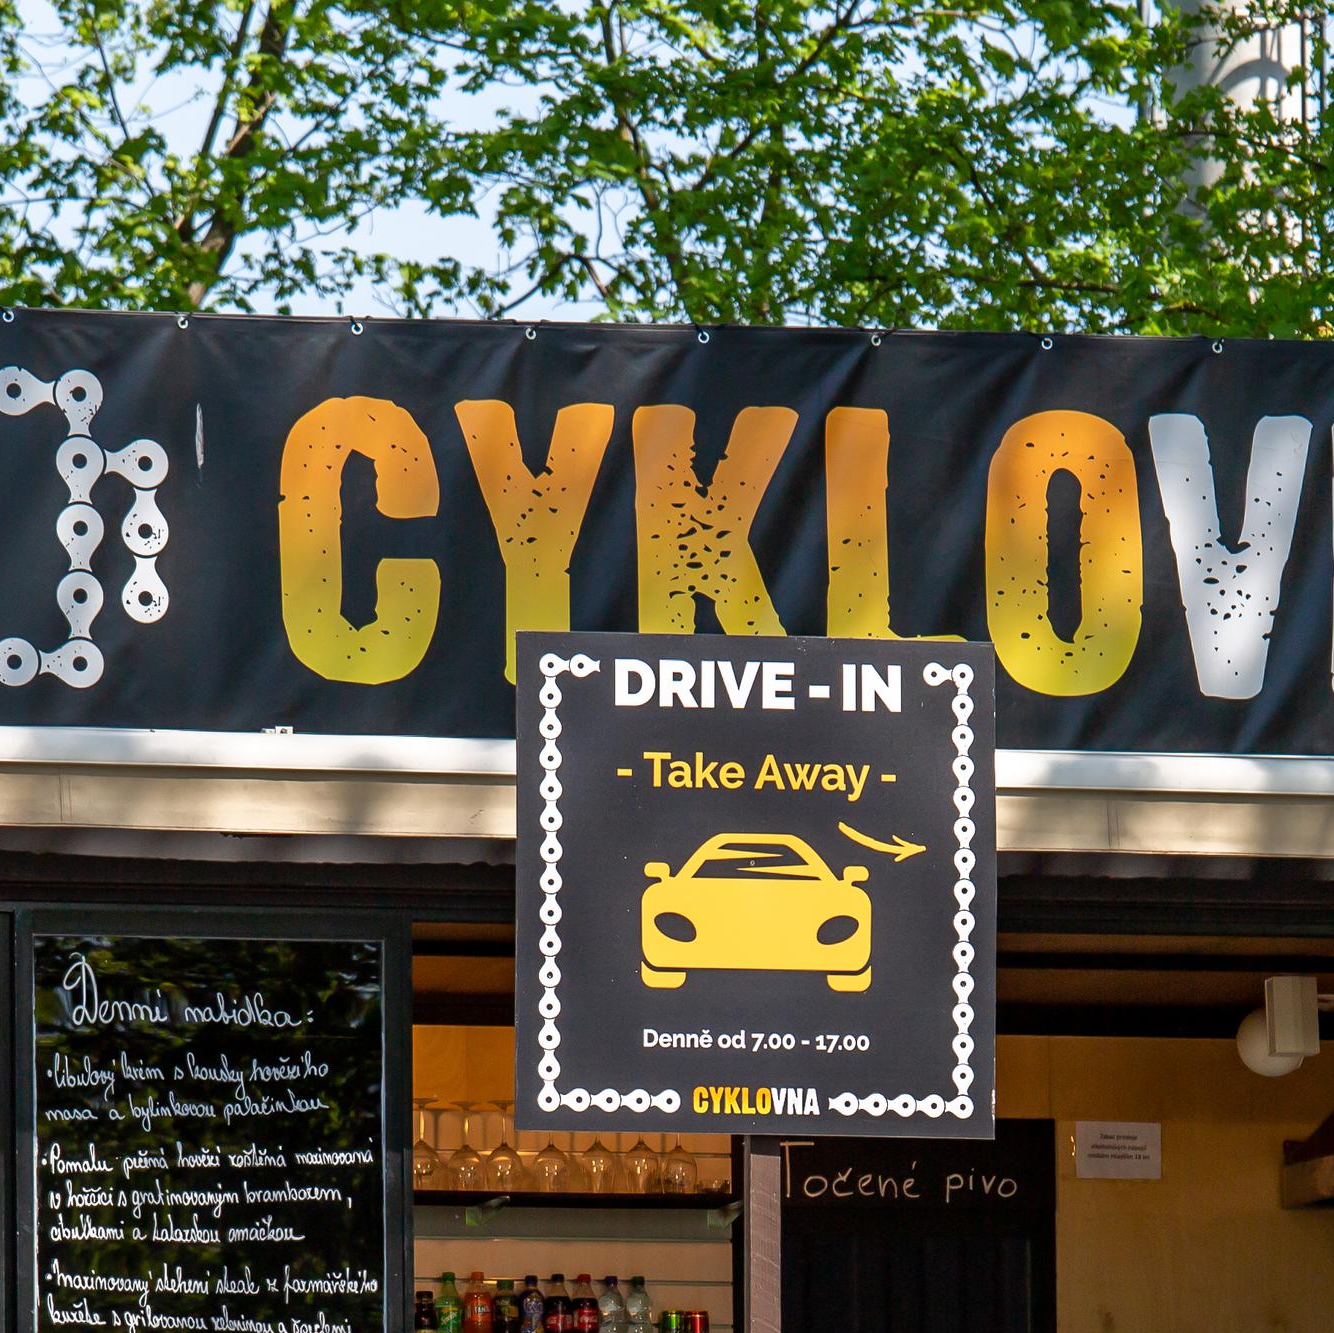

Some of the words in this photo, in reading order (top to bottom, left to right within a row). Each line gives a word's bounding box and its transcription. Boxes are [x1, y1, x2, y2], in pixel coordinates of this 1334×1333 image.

[614, 658, 796, 711] DRIVE
[842, 664, 902, 713] IN
[642, 751, 746, 790] Take
[754, 754, 870, 801] Away
[642, 1028, 713, 1049] Denně
[717, 1029, 747, 1050] od
[751, 1032, 797, 1053] 7.00
[815, 1033, 871, 1053] 17.00
[45, 1108, 98, 1121] masa
[109, 1108, 125, 1121] a
[692, 1085, 821, 1116] CYKLOVNA
[779, 1141, 922, 1199] Točené
[945, 1167, 1018, 1203] pivo
[132, 1225, 147, 1242] a
